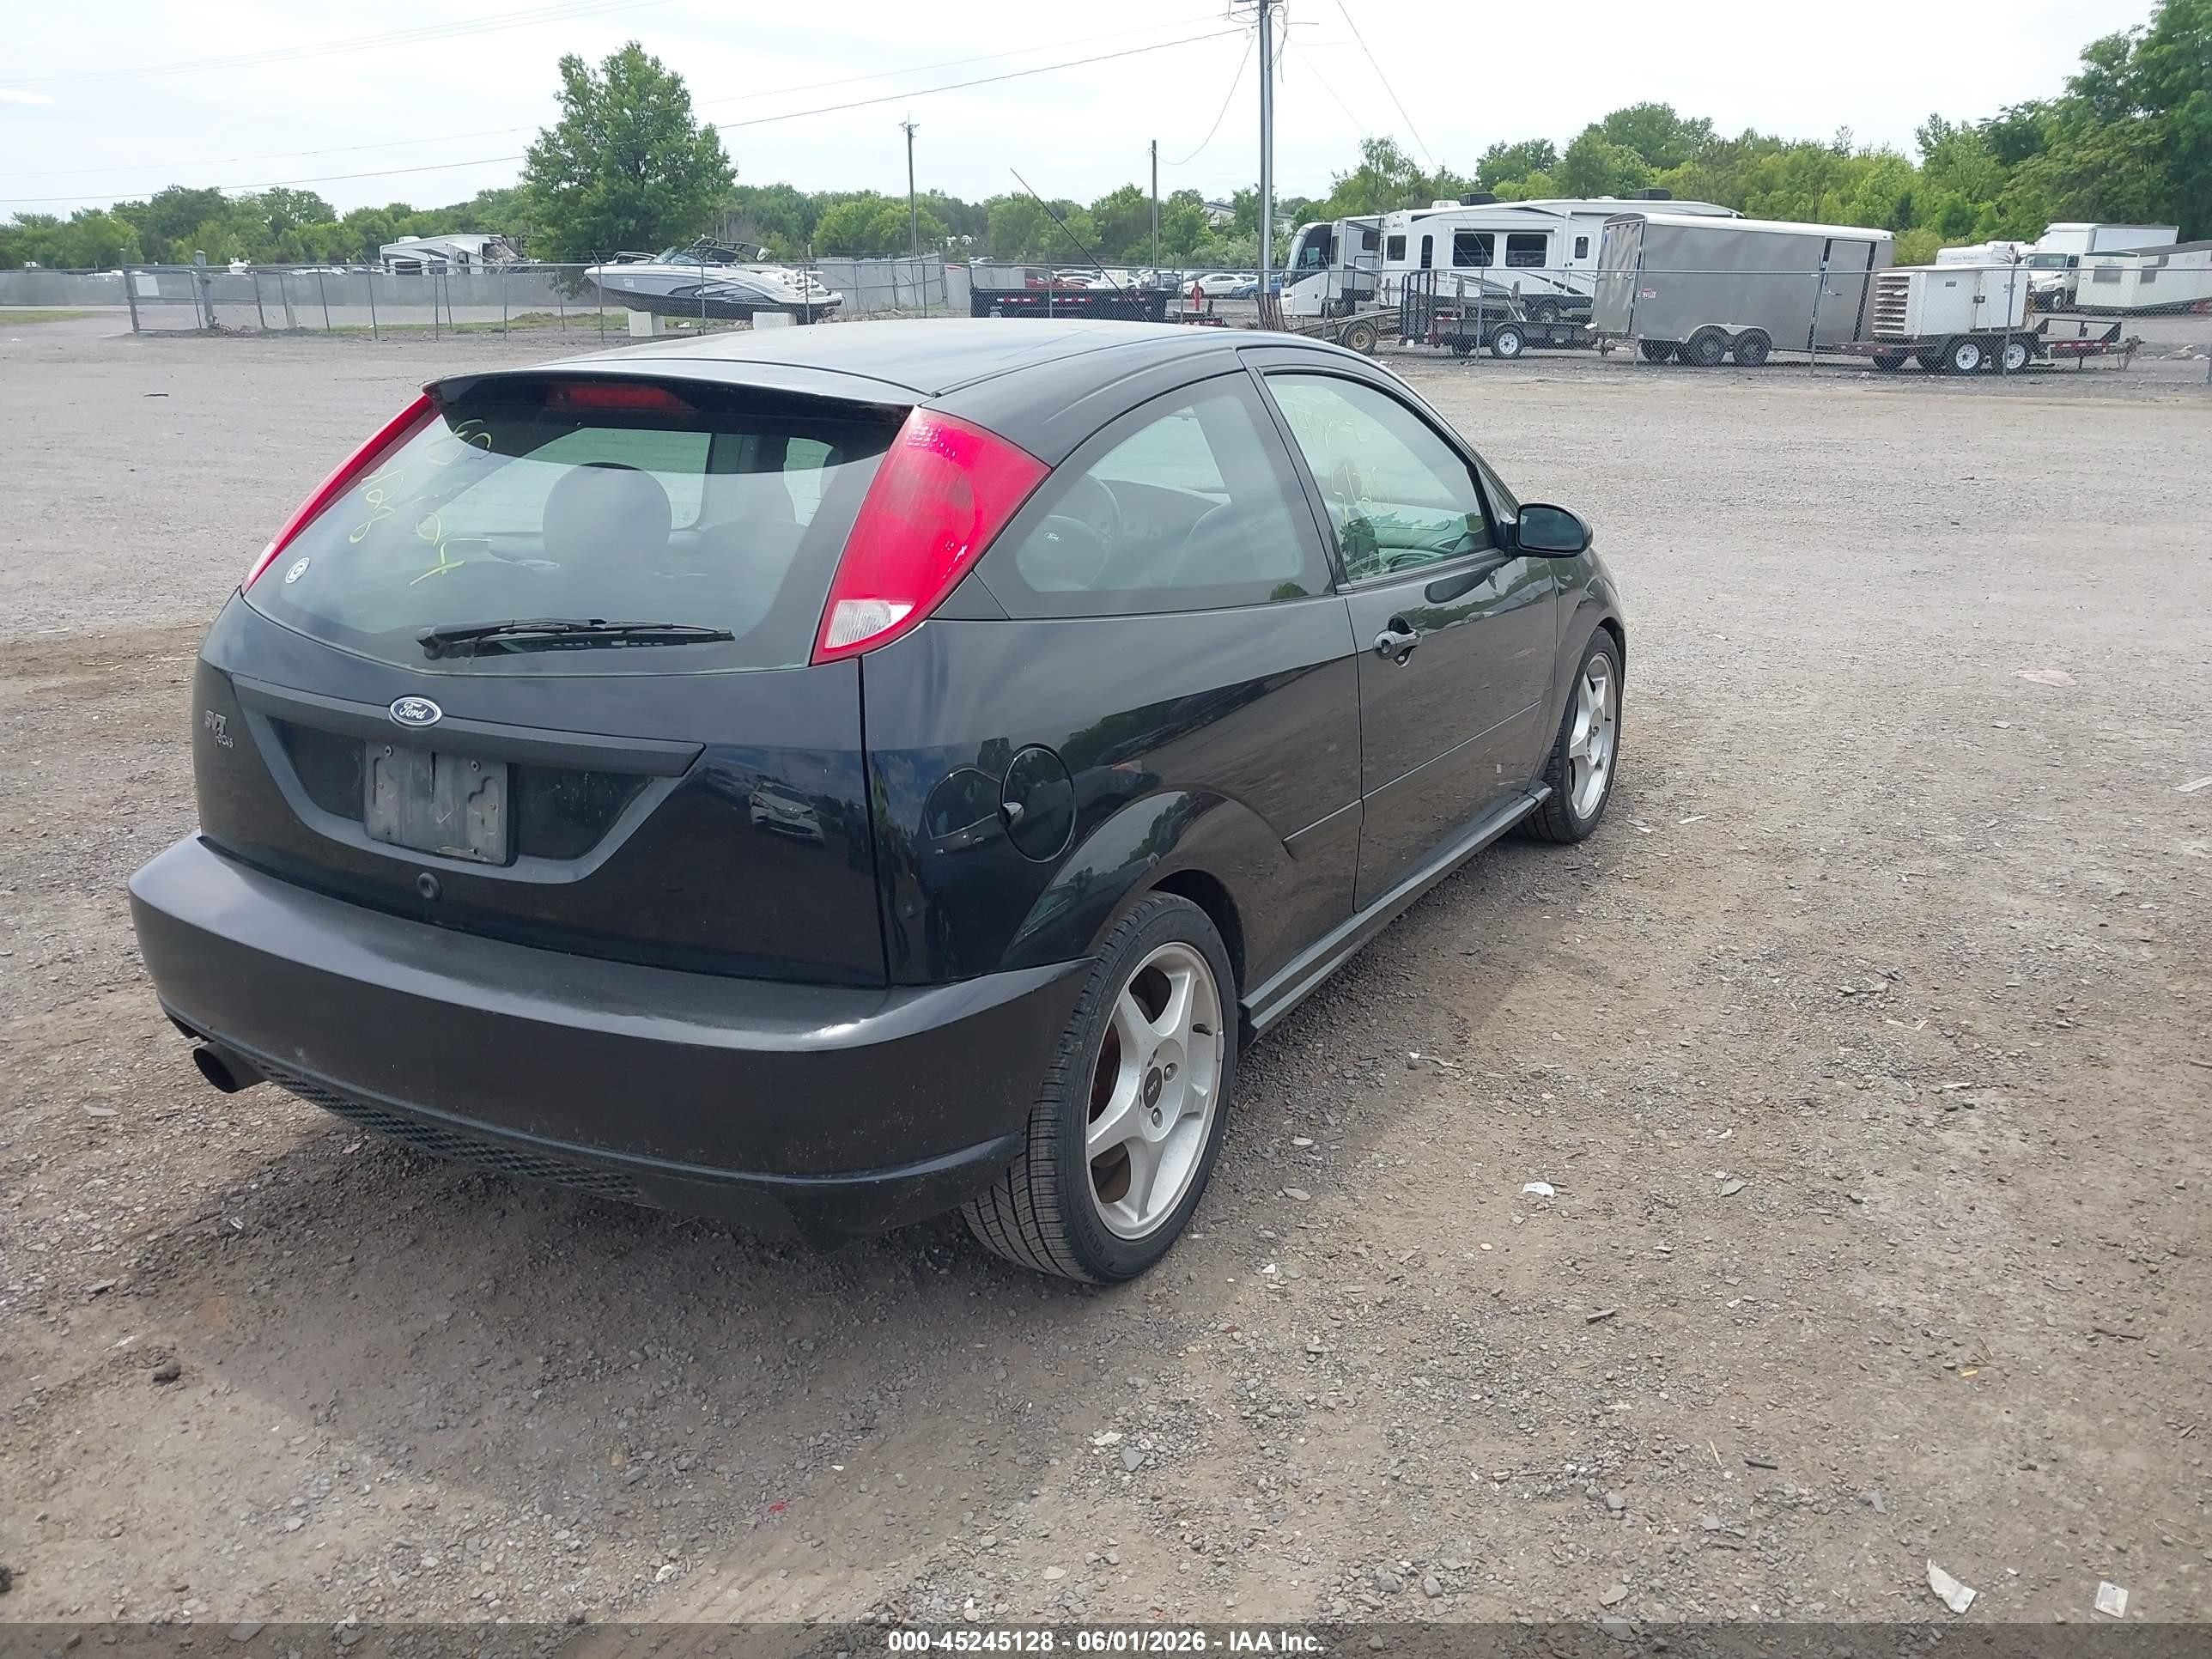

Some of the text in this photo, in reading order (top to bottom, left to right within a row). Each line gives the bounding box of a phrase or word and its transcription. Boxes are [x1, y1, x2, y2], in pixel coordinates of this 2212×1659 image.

[398, 702, 428, 720] Ford
[204, 709, 227, 734] SVT
[1147, 1079, 1158, 1097] SVT
